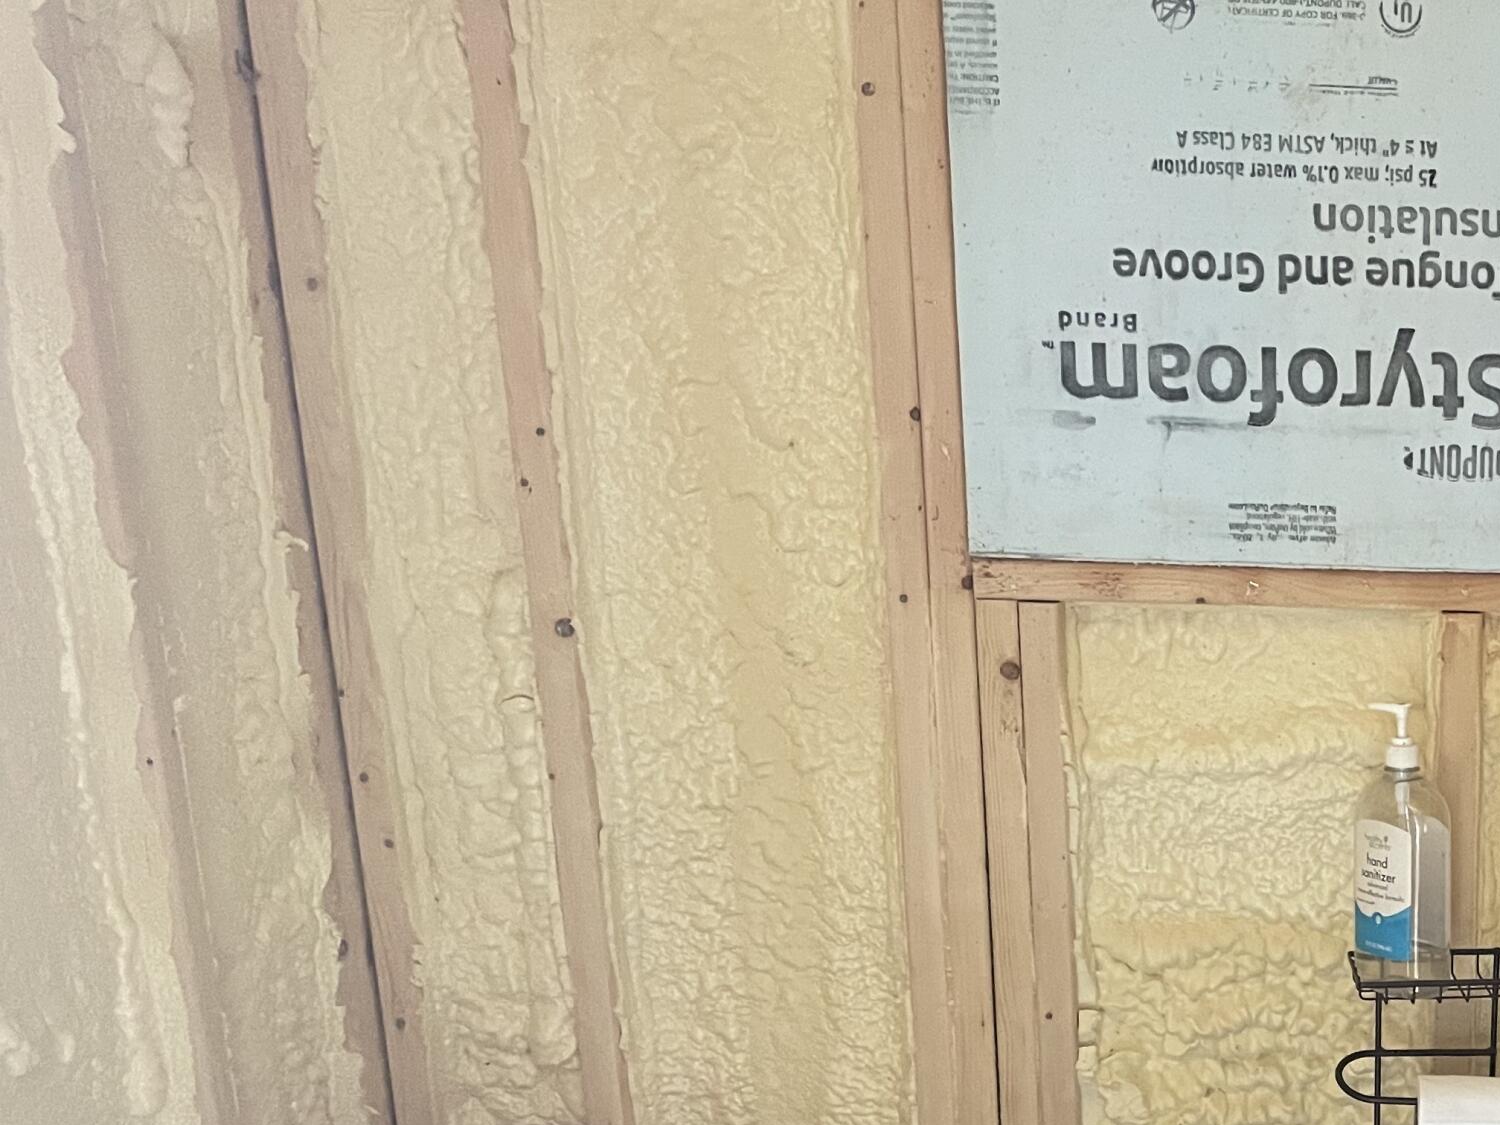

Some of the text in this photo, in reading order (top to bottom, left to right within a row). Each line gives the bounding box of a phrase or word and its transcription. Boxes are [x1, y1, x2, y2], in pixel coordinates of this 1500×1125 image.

[1176, 130, 1188, 149] A
[1192, 131, 1235, 151] Class
[1241, 133, 1272, 152] E84
[1278, 134, 1325, 155] ASTM
[1330, 132, 1378, 156] thick,
[1419, 140, 1437, 157] At
[1151, 155, 1437, 189] 25 psi; max 0.1% water absorption
[1113, 247, 1265, 292] Groove
[1278, 254, 1356, 297] and
[1058, 310, 1137, 333] Brand
[1366, 853, 1388, 870] hand
[1361, 868, 1396, 884] sanitizer
